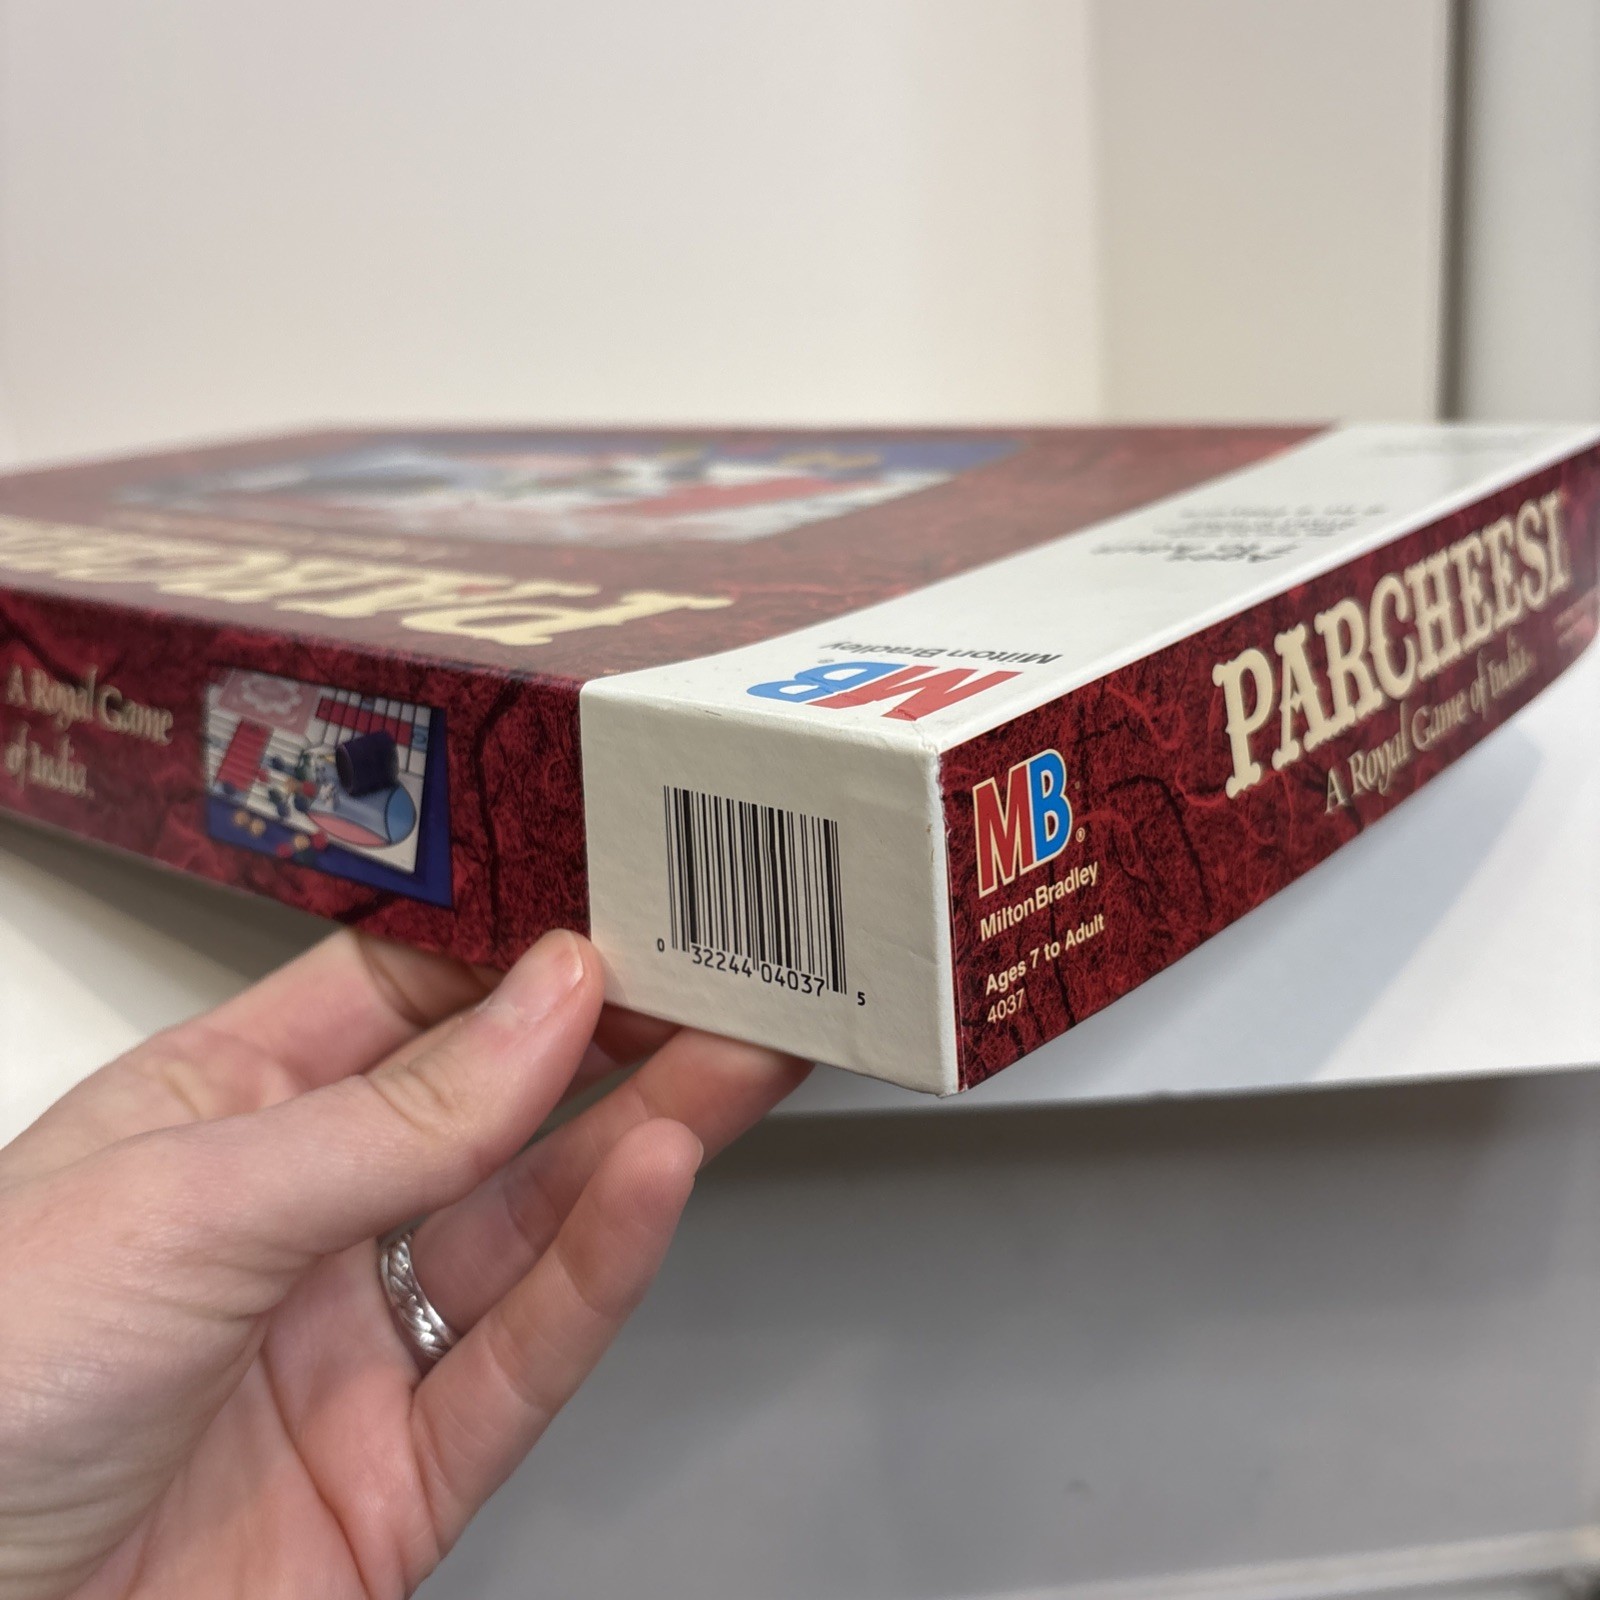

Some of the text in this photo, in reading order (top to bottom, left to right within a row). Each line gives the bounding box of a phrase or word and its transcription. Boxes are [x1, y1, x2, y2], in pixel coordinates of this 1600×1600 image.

[1212, 488, 1571, 799] PARCHEESI
[6, 664, 174, 747] A Royal Game
[1325, 765, 1348, 816] A
[1347, 701, 1410, 797] Royal
[1411, 688, 1471, 751] Game
[1470, 649, 1490, 722] of
[5, 720, 31, 792] of
[656, 937, 866, 1007] 0 32244 04037 5
[985, 913, 1105, 996] Ages 7 to Adult
[987, 987, 1026, 1024] 4037
